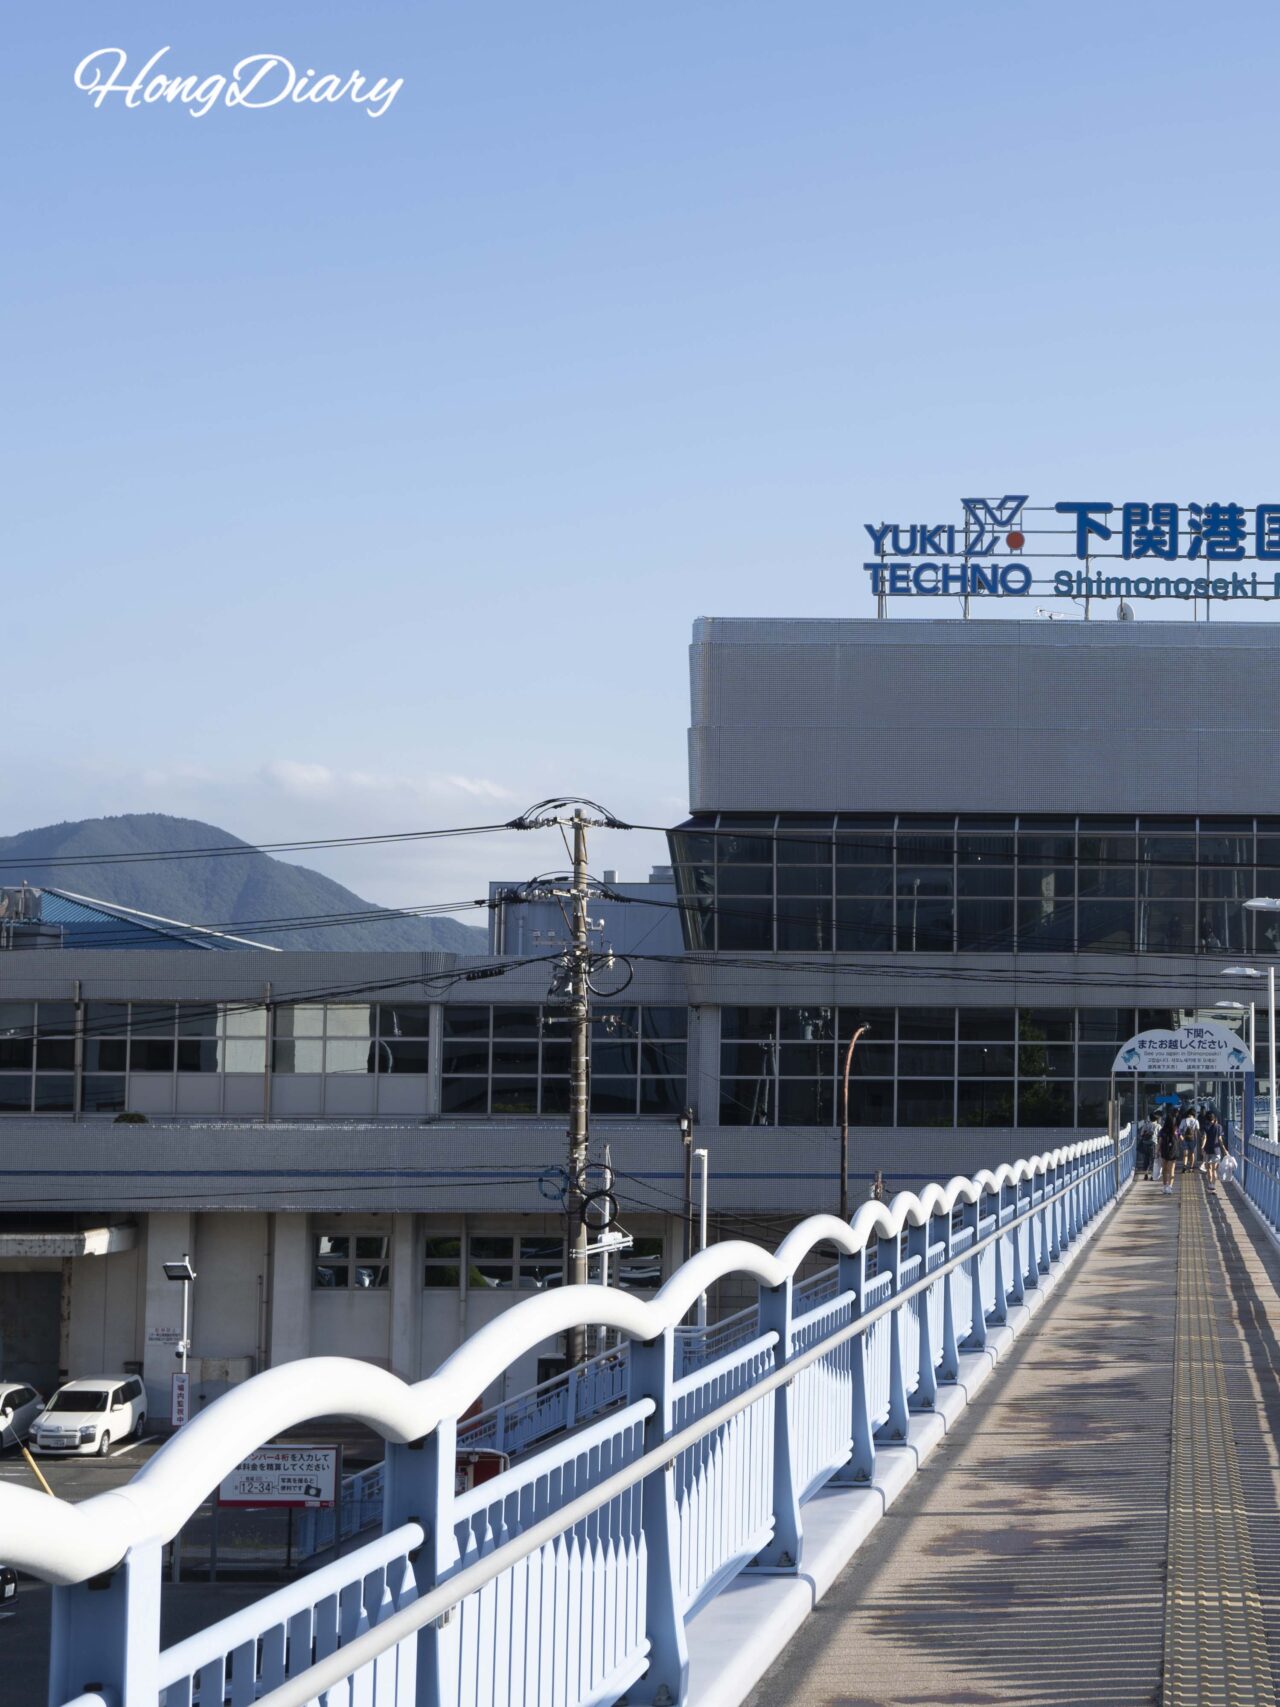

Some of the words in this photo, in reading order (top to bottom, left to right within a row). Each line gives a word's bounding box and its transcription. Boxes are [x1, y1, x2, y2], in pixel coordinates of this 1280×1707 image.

[863, 524, 955, 556] YUKI
[863, 562, 1032, 595] TECHNO
[1053, 570, 1257, 598] Shimonoseki
[1183, 1028, 1214, 1039] 下関へ
[1138, 1039, 1228, 1050] またお越しください
[241, 1482, 271, 1493] 12-34
